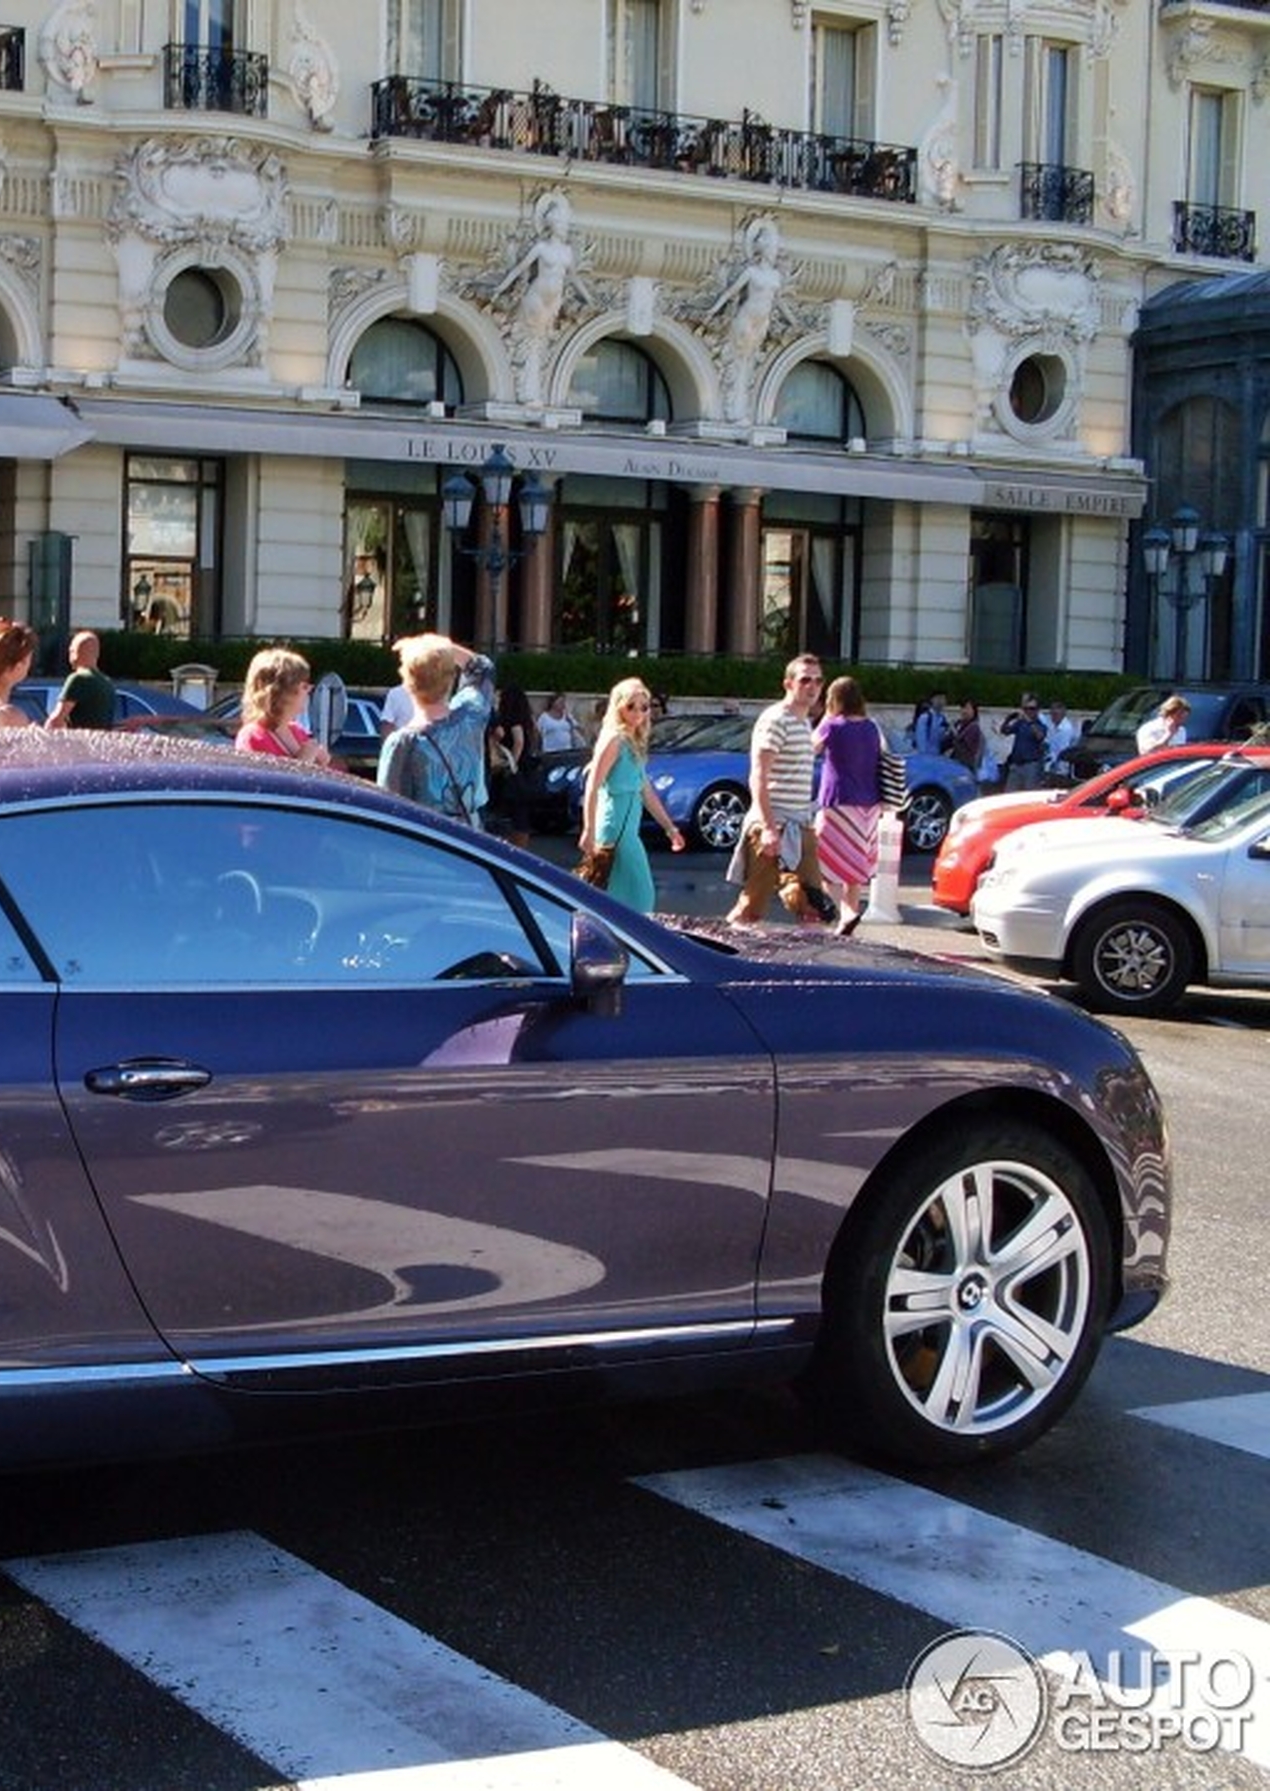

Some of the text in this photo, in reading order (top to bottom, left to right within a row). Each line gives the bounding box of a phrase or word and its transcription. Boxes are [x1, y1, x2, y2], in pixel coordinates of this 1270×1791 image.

[406, 440, 435, 457] LE
[528, 448, 557, 467] XV
[995, 488, 1128, 515] SALLE EMPIRE
